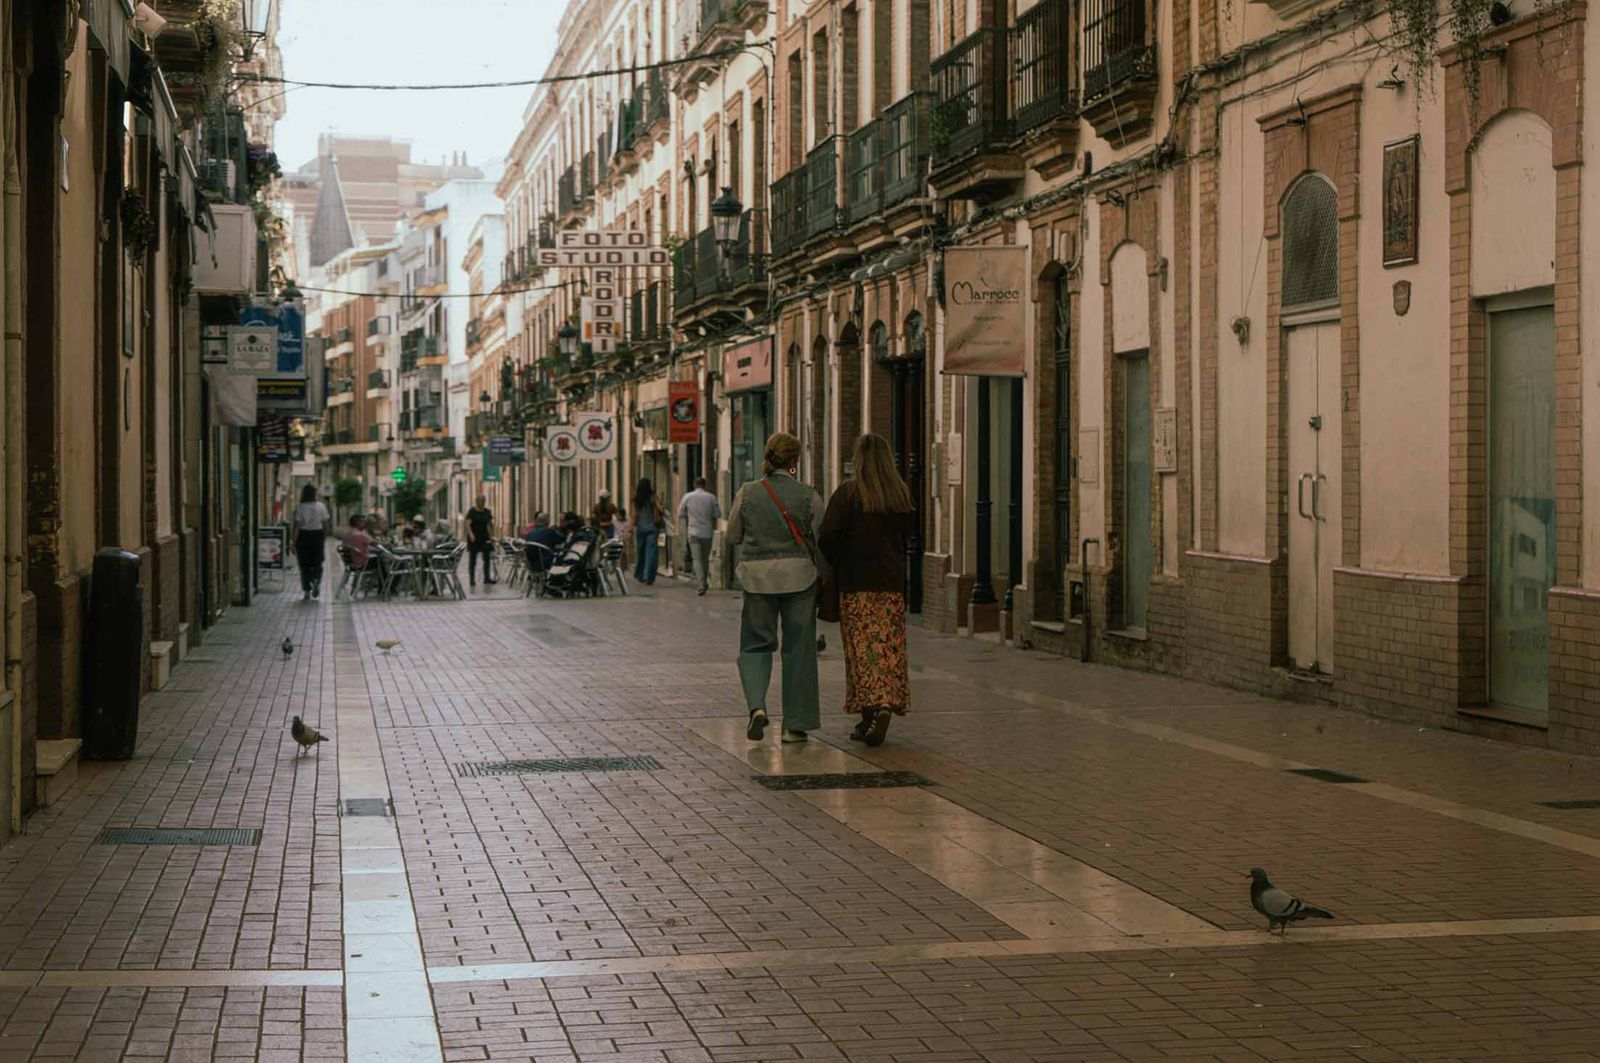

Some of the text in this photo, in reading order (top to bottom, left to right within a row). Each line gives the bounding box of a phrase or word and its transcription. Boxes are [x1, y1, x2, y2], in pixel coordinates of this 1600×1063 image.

[562, 232, 645, 246] FOTO
[541, 251, 667, 265] STUDIO
[595, 270, 613, 352] RODRI
